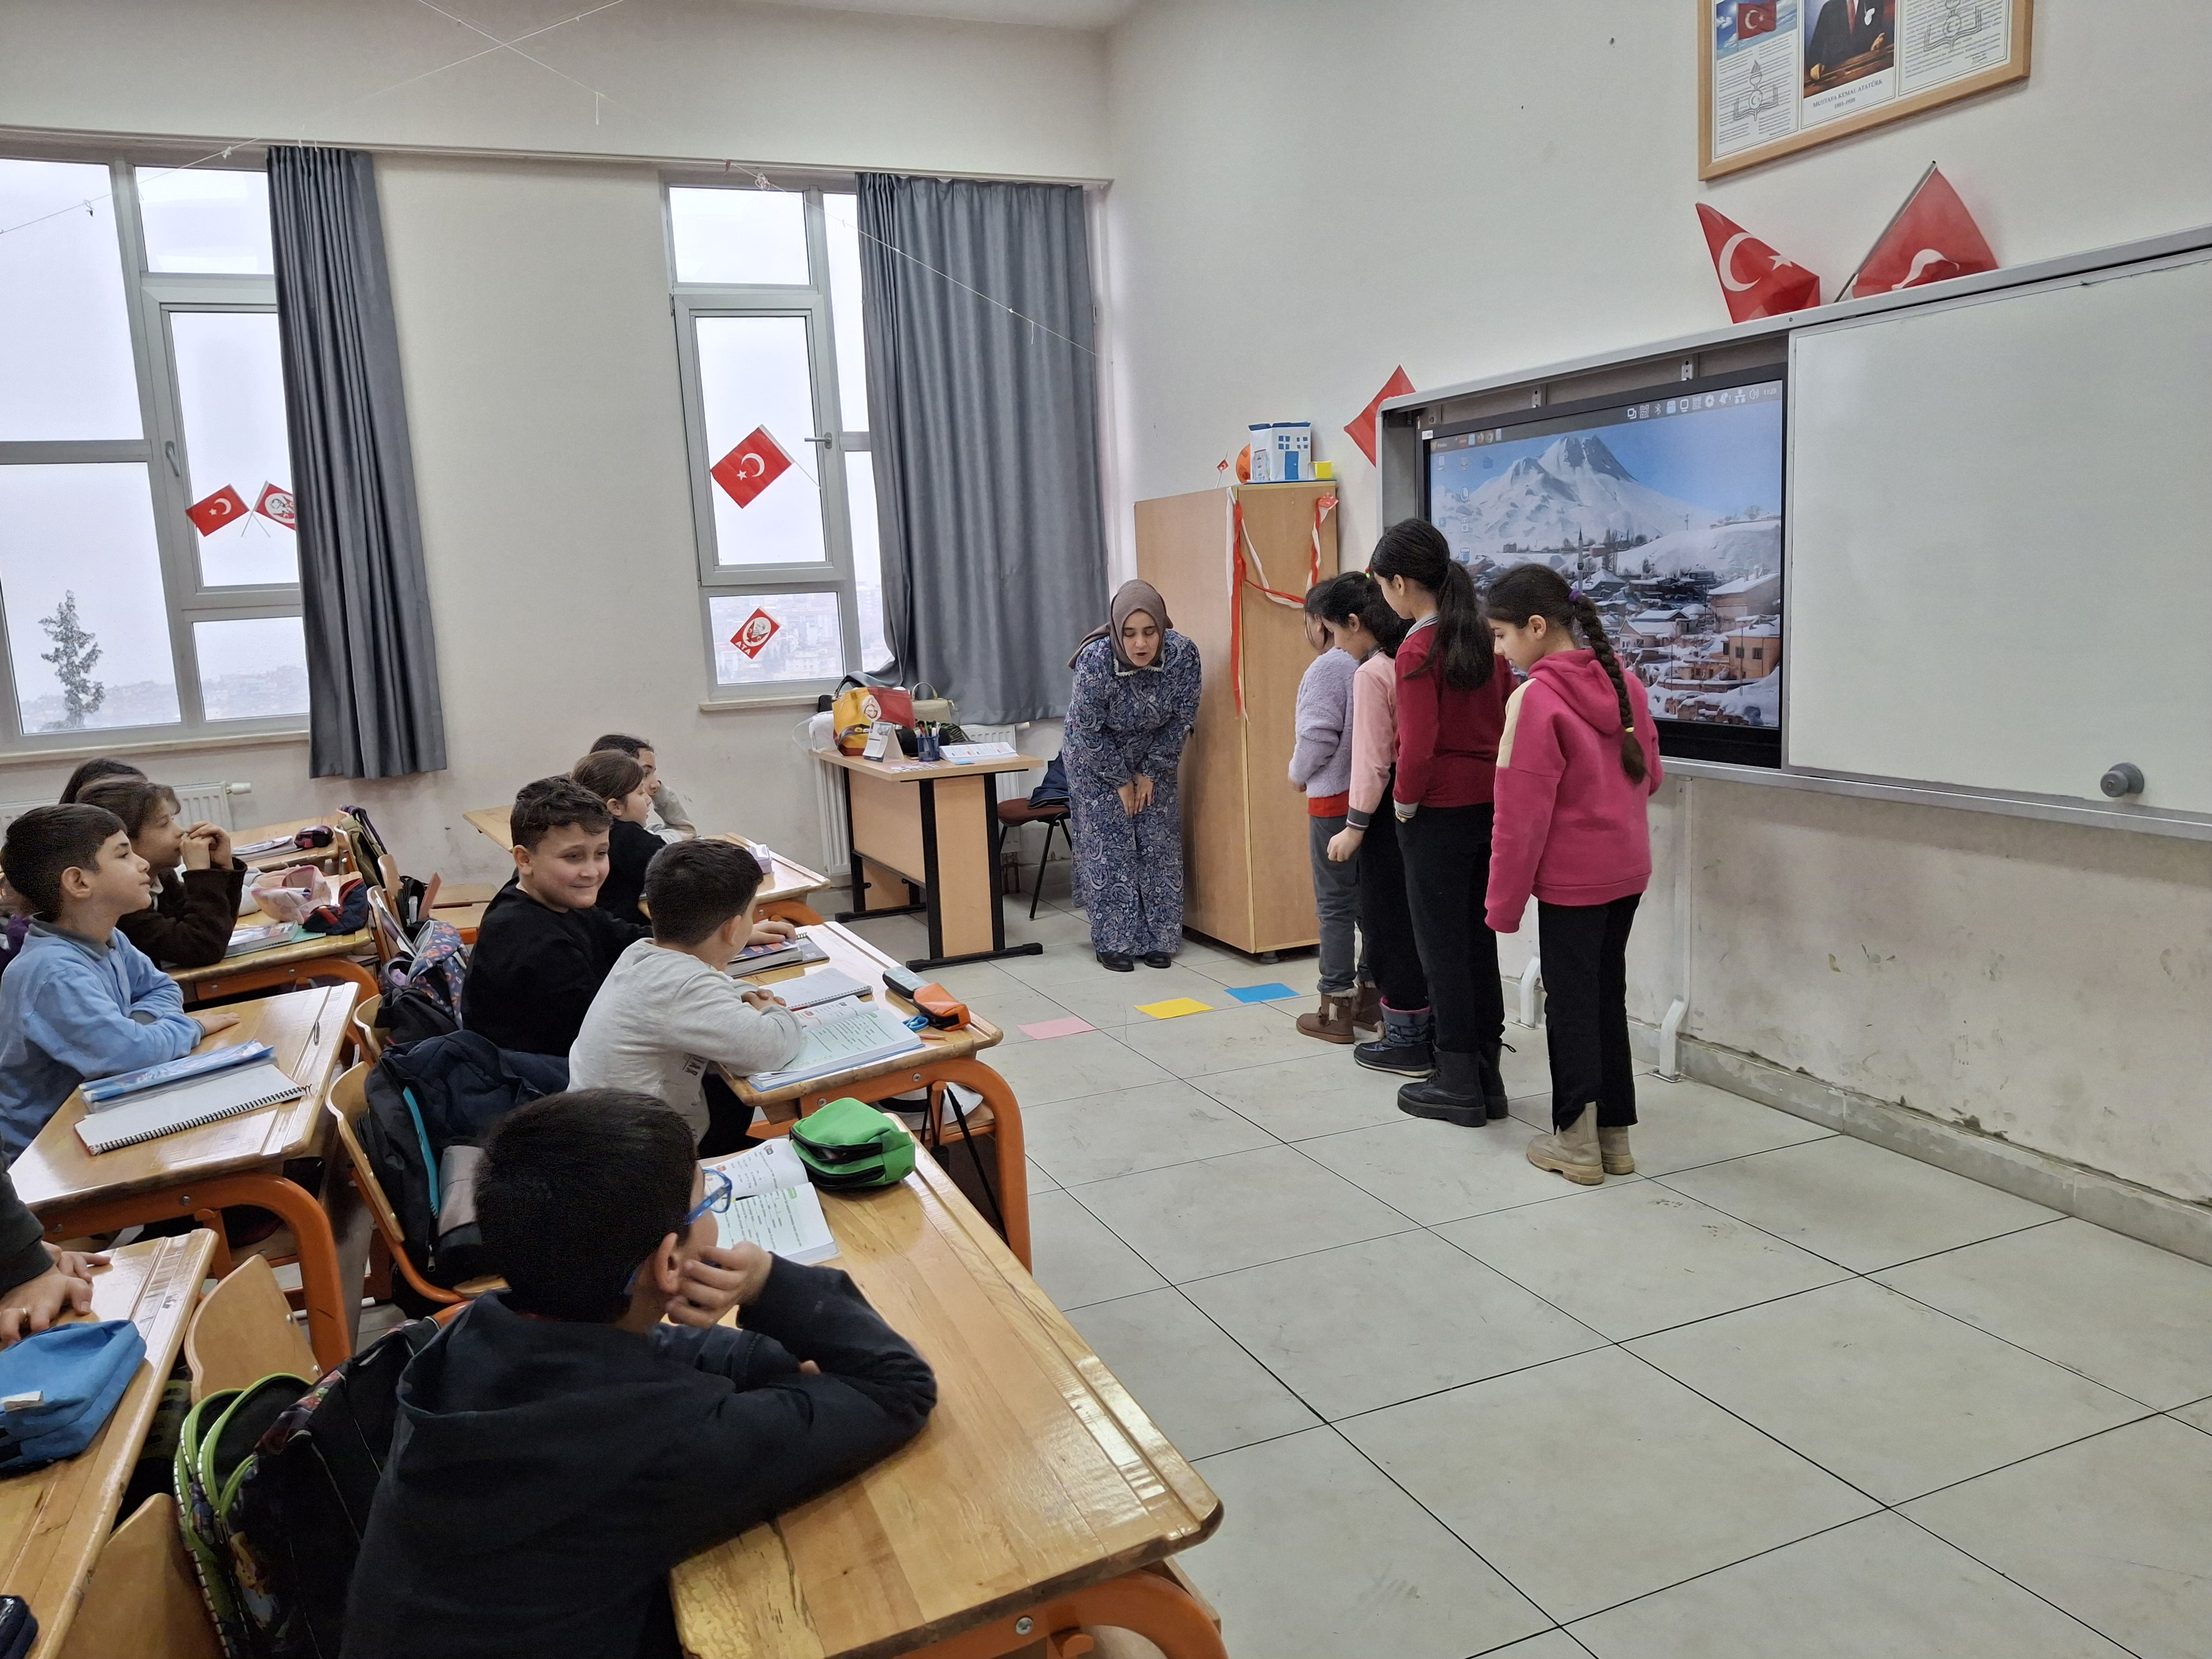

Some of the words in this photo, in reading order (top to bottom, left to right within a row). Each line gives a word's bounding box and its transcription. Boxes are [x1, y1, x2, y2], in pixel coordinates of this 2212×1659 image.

[1813, 96, 1837, 107] MUSTAFA
[1838, 88, 1856, 99] KEMAL
[1857, 79, 1883, 92] ATATÜRK
[735, 641, 751, 655] ATA
